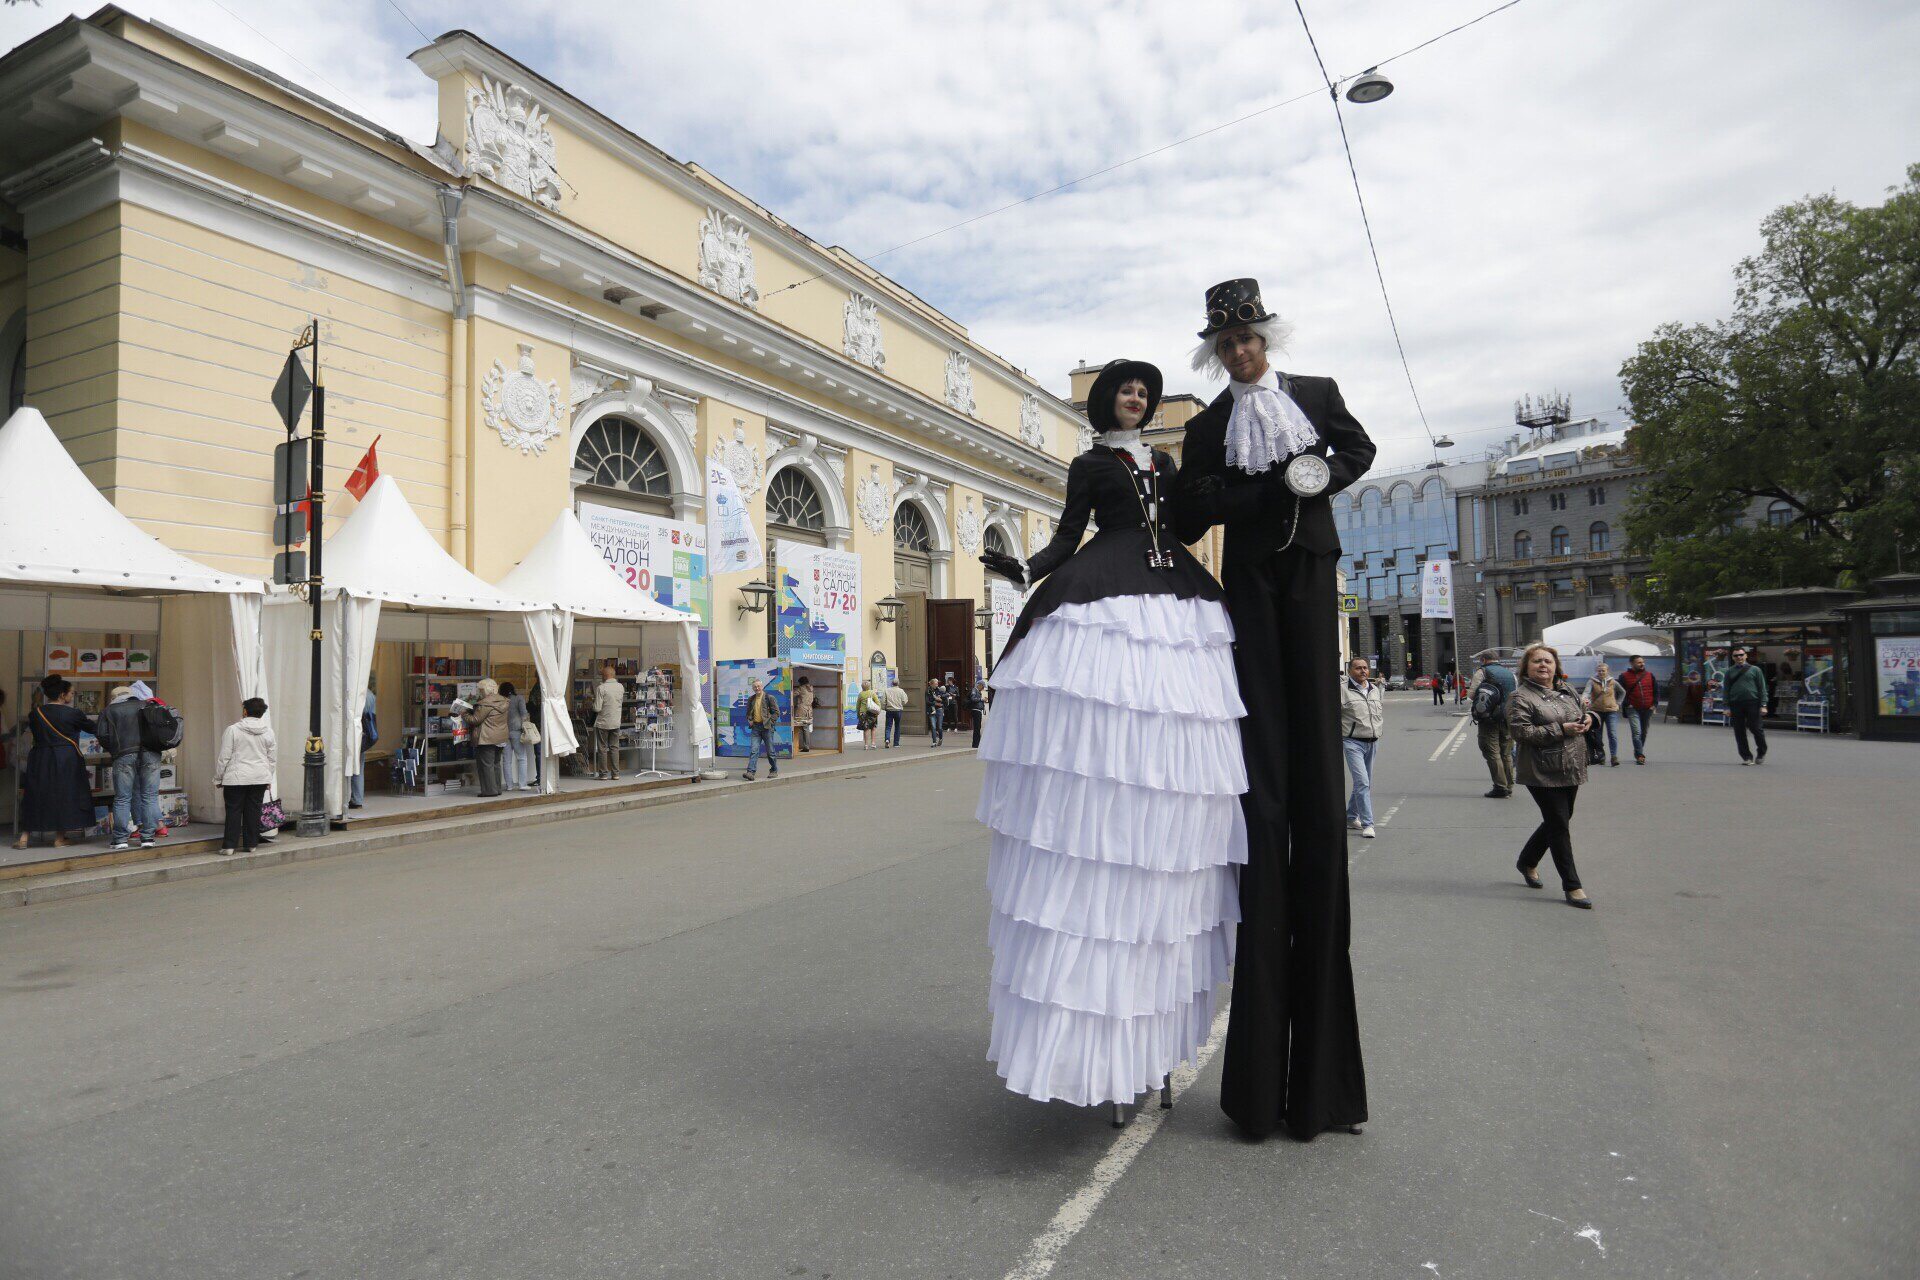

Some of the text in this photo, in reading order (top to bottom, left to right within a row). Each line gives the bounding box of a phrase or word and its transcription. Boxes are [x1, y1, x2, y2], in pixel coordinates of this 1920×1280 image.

[591, 514, 650, 530] САНКТ-ПЕТЕРБУРГСКИЙ
[590, 523, 650, 540] МЕЖДУНАРОДНЫЙ
[590, 531, 650, 551] КНИЖНЫЙ
[593, 545, 650, 567] АЛОН
[625, 567, 651, 590] 20
[823, 568, 856, 580] КНИЖНЫЙ
[823, 578, 856, 593] САЛОН
[823, 591, 857, 611] 17 20
[1883, 659, 1900, 668] 17
